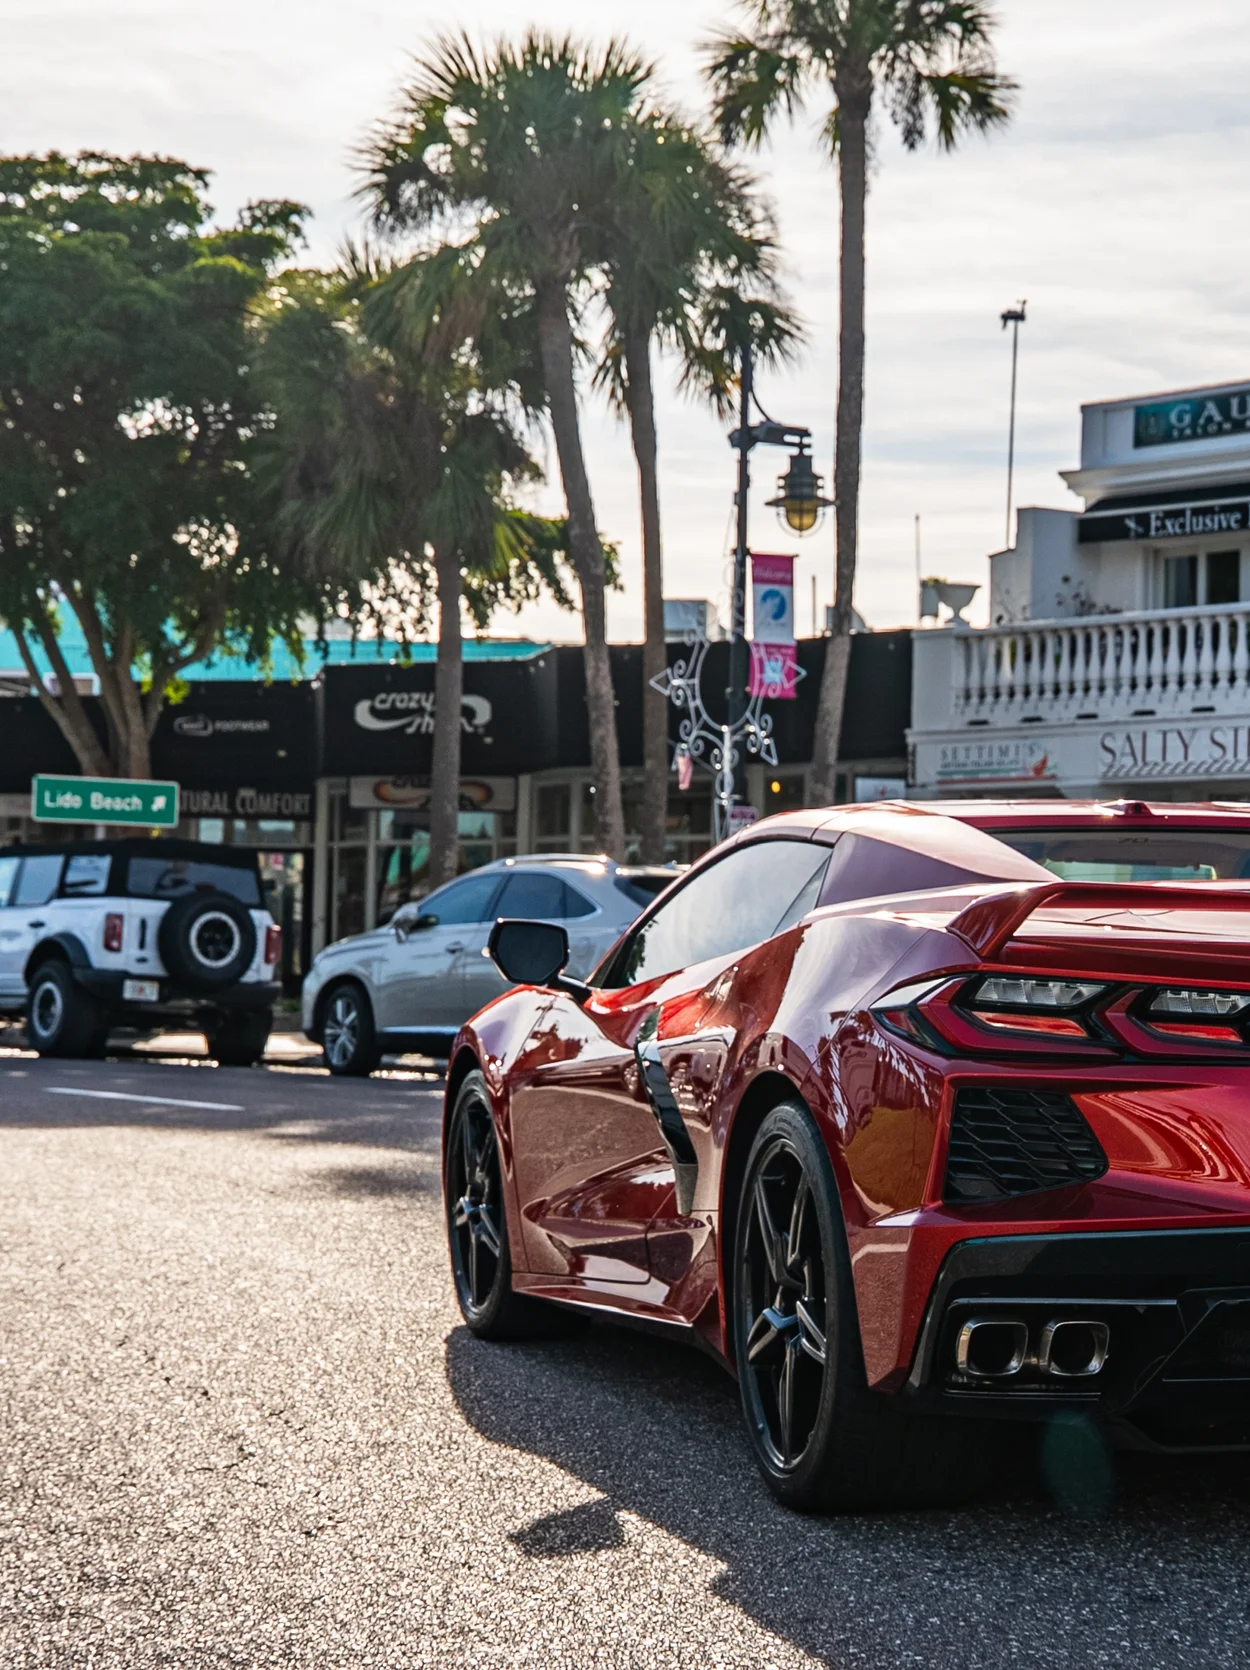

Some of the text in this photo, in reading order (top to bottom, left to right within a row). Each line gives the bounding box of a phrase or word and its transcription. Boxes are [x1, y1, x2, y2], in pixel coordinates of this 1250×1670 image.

[1171, 421, 1232, 438] SALON
[1149, 506, 1242, 536] Exclusive
[373, 692, 435, 711] crazy
[215, 720, 270, 731] FOOTWEAR
[1100, 728, 1198, 765] SALTY
[44, 791, 143, 812] Lido Beach
[235, 790, 312, 815] COMFORT
